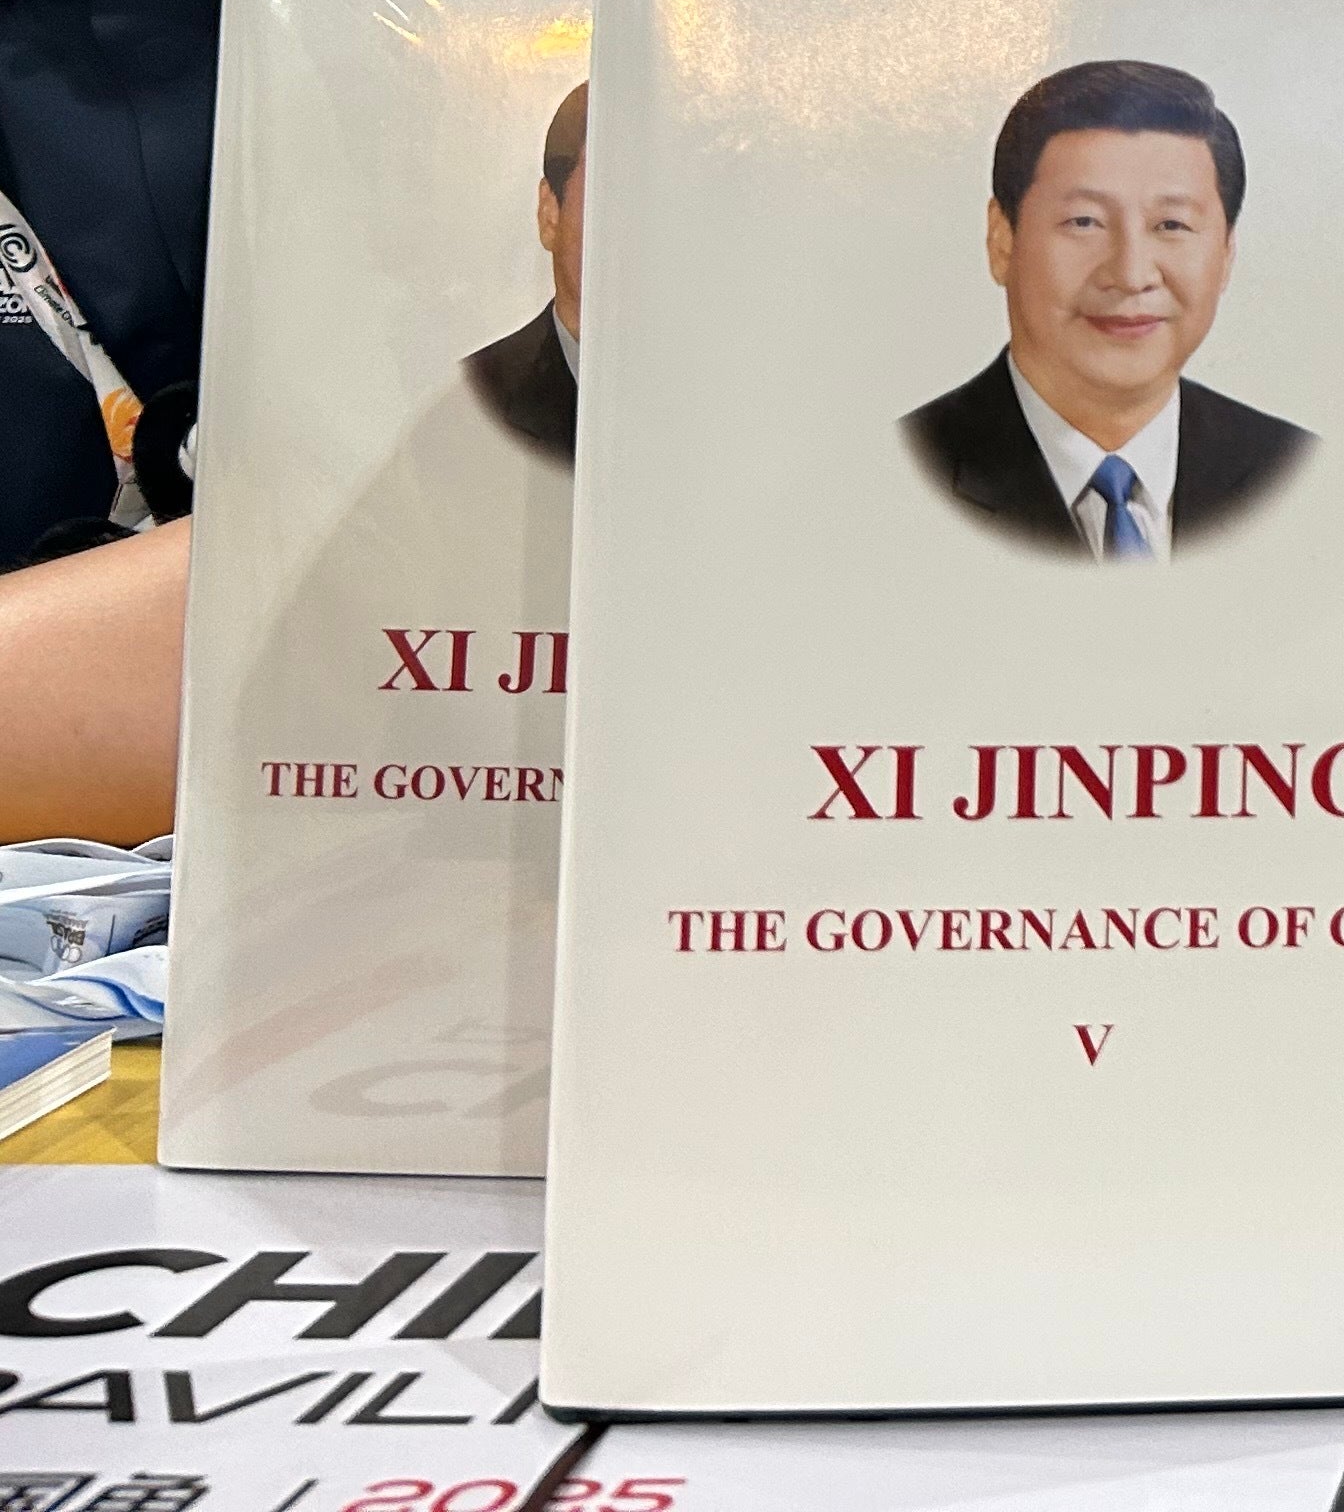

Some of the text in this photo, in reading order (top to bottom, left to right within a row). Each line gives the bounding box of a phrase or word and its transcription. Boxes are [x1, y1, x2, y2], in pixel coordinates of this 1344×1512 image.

[378, 629, 476, 691] XI
[262, 762, 358, 798] THE
[807, 745, 925, 820] XI
[669, 910, 787, 953] THE
[806, 906, 1220, 952] GOVERNANCE
[1238, 906, 1316, 950] OF
[1073, 1024, 1114, 1067] V
